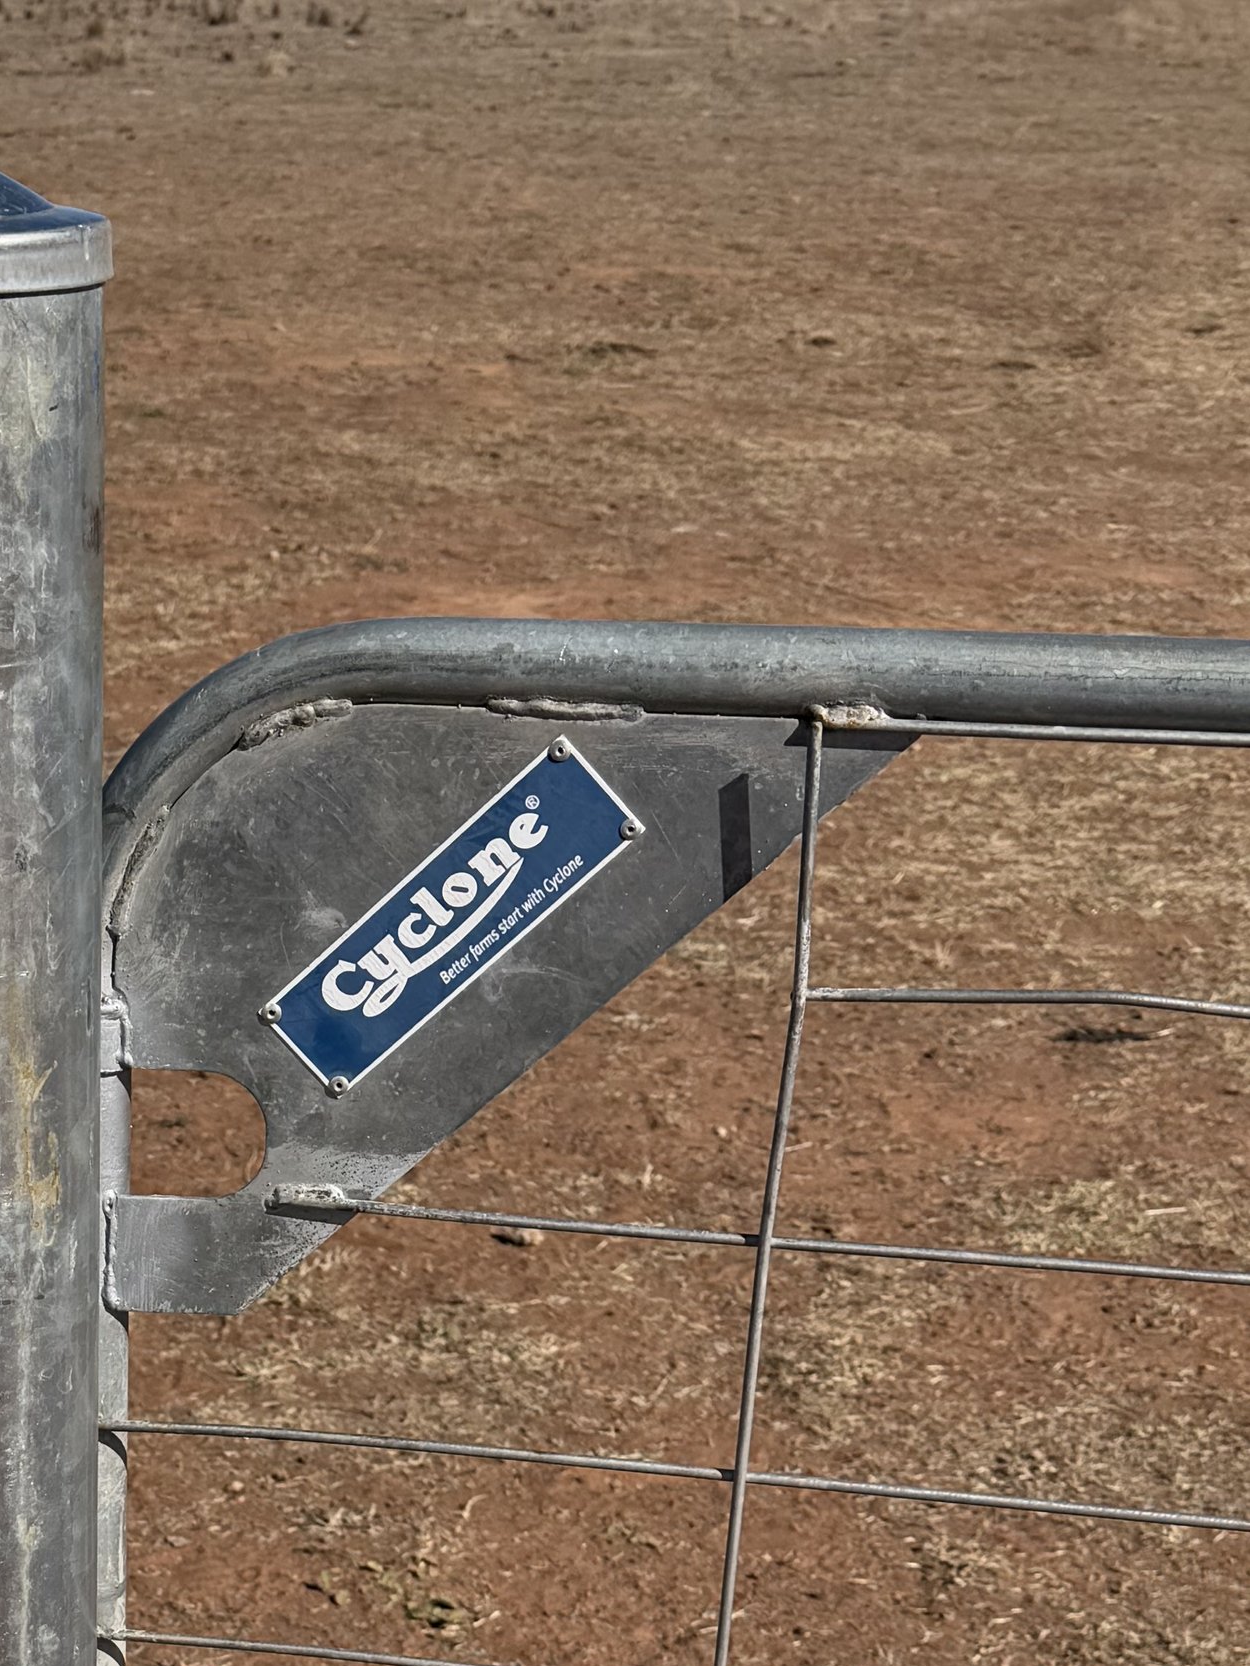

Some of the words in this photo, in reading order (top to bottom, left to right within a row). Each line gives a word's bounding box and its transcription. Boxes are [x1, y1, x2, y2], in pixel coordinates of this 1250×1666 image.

[439, 953, 471, 985] Better
[469, 929, 500, 962] farms
[498, 907, 524, 934] start
[521, 888, 546, 913] with
[543, 855, 584, 893] Cyclone
